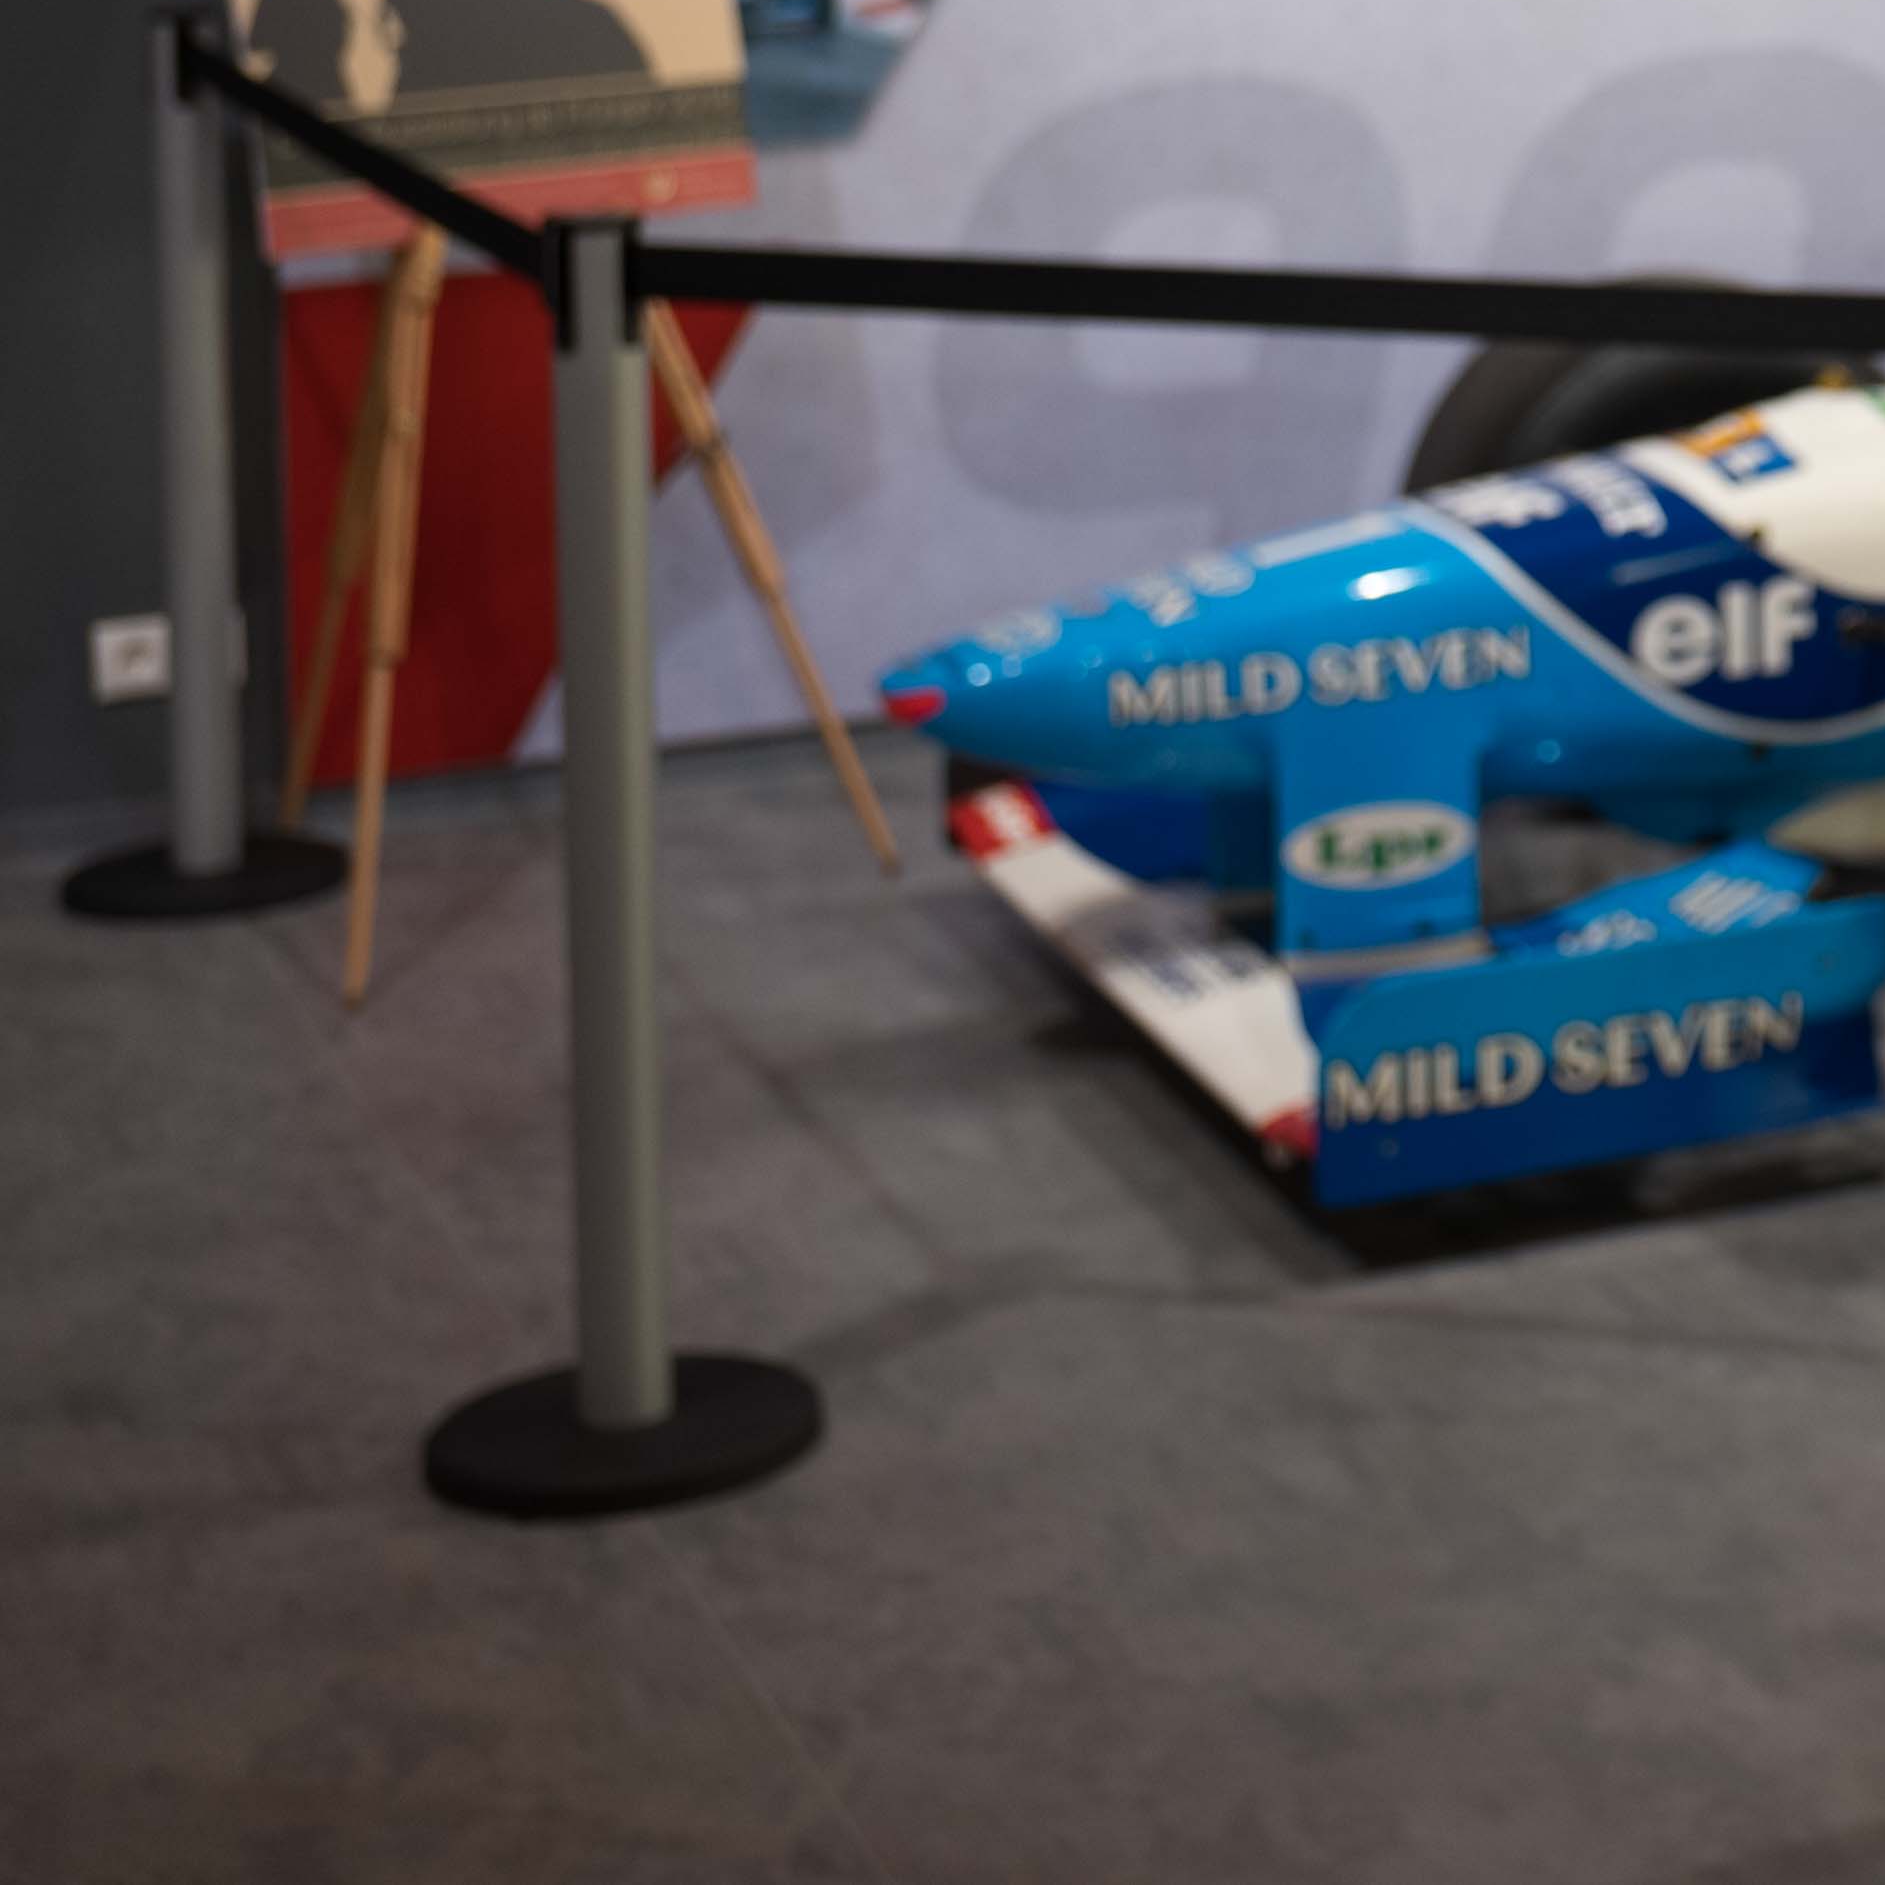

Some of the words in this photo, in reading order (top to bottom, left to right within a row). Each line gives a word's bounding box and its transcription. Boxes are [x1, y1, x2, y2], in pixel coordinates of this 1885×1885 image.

[1108, 651, 1301, 727] MILD
[1307, 628, 1531, 708] SEVEN
[1632, 586, 1817, 687] elf
[1326, 1040, 1539, 1128] MILD
[1553, 996, 1803, 1092] SEVEN
